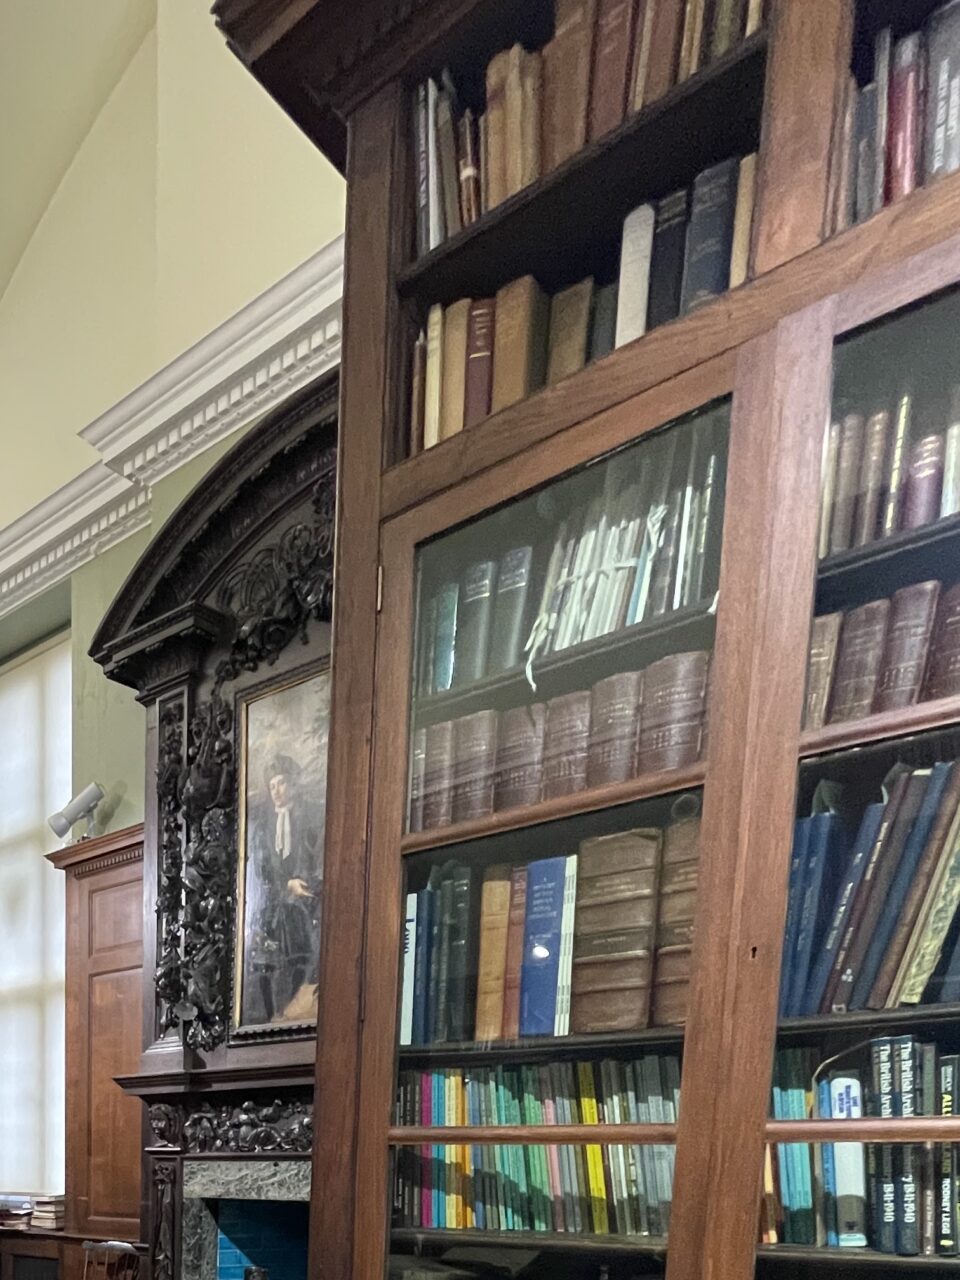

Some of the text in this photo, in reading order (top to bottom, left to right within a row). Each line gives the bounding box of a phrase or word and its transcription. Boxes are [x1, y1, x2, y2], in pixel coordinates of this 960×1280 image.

[880, 1044, 890, 1060] The
[900, 1042, 910, 1059] The
[880, 1061, 890, 1092] British
[901, 1060, 912, 1091] British
[881, 1093, 892, 1118] Archi
[902, 1092, 914, 1117] Archi
[882, 1183, 894, 1222] 1841-1940
[903, 1183, 915, 1222] 1841-1940
[941, 1178, 950, 1212] RODNEY
[941, 1213, 950, 1234] LEGG
